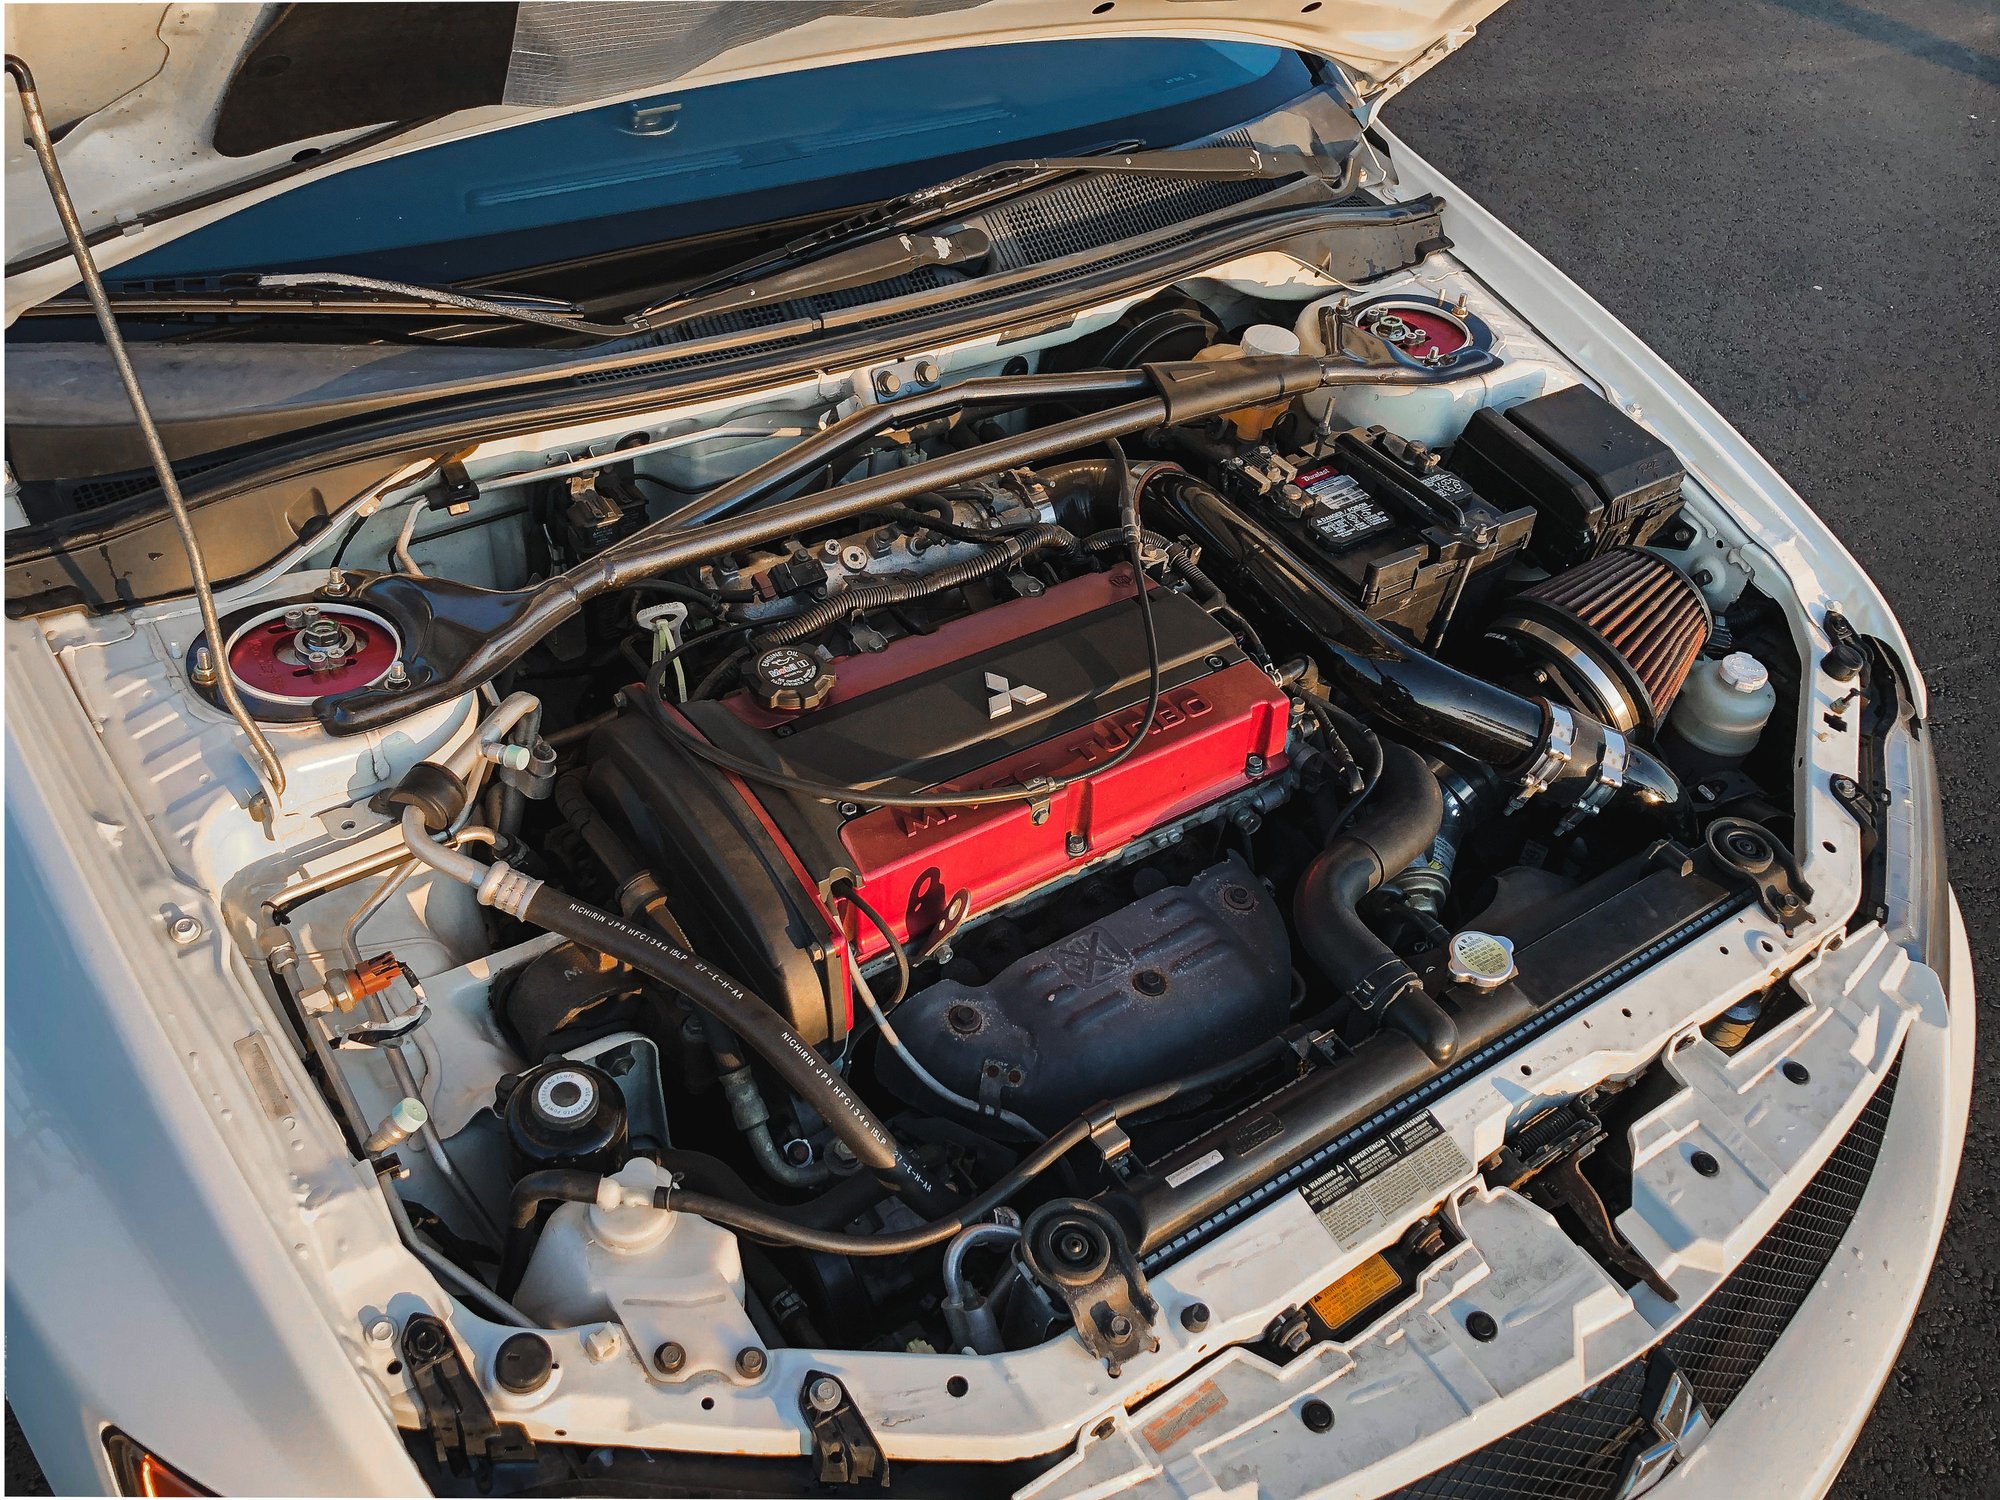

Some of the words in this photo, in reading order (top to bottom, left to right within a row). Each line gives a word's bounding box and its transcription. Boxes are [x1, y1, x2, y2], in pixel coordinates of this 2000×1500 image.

[1301, 468, 1330, 482] Duralast
[761, 651, 784, 667] ENGINE
[786, 650, 799, 658] OIL
[768, 663, 798, 677] Mobil
[569, 902, 606, 923] NICHIRIN
[608, 920, 626, 932] JPN
[669, 947, 689, 961] 15LP
[781, 1031, 817, 1067] NICHIRIN
[815, 1067, 834, 1086] JPN
[870, 1126, 888, 1146] 15LP
[1390, 1110, 1430, 1139] AVERTISSEMENT
[1348, 1138, 1387, 1165] ADVERTENCIA
[1308, 1169, 1337, 1189] WARNING
